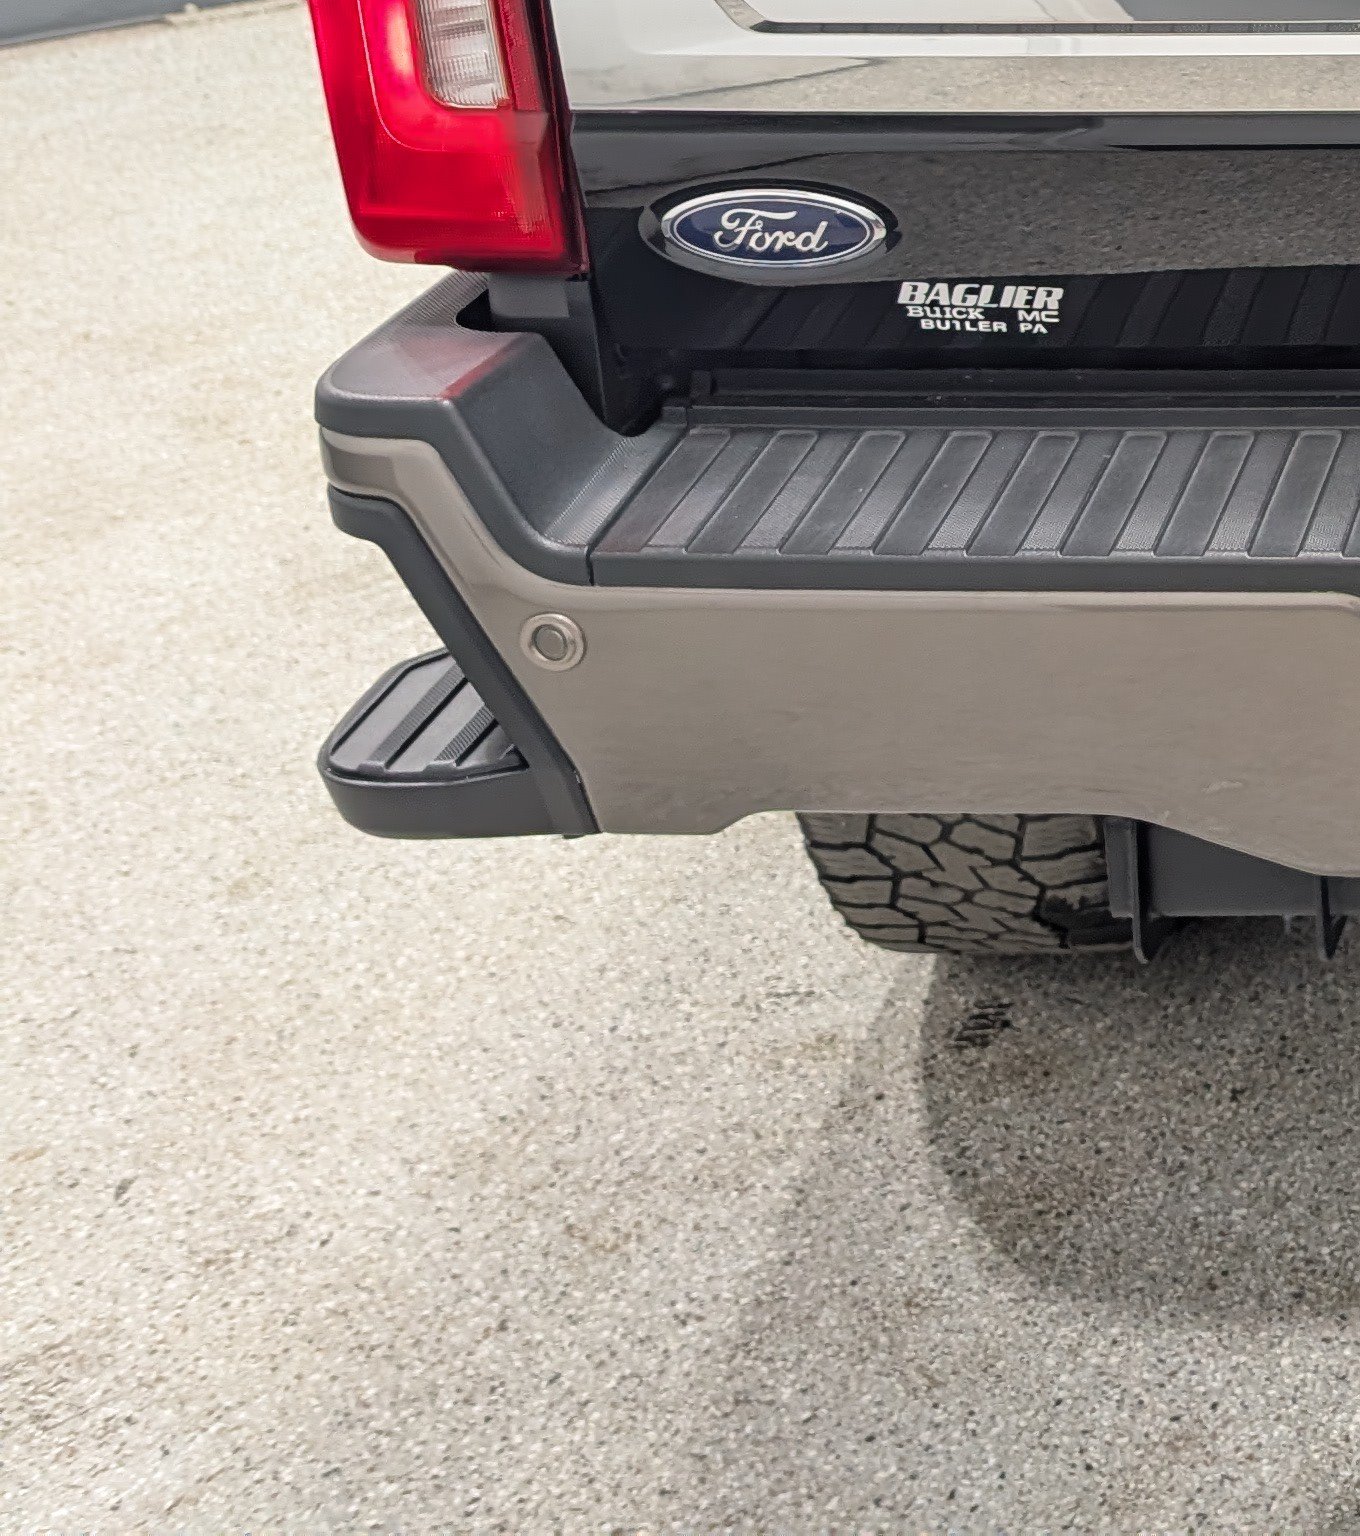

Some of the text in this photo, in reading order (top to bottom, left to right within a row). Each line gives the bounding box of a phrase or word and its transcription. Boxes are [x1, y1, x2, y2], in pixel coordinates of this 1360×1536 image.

[713, 207, 829, 253] Ford
[897, 281, 1064, 310] BAGLIER
[906, 305, 986, 320] BUICK
[1018, 322, 1049, 334] PA
